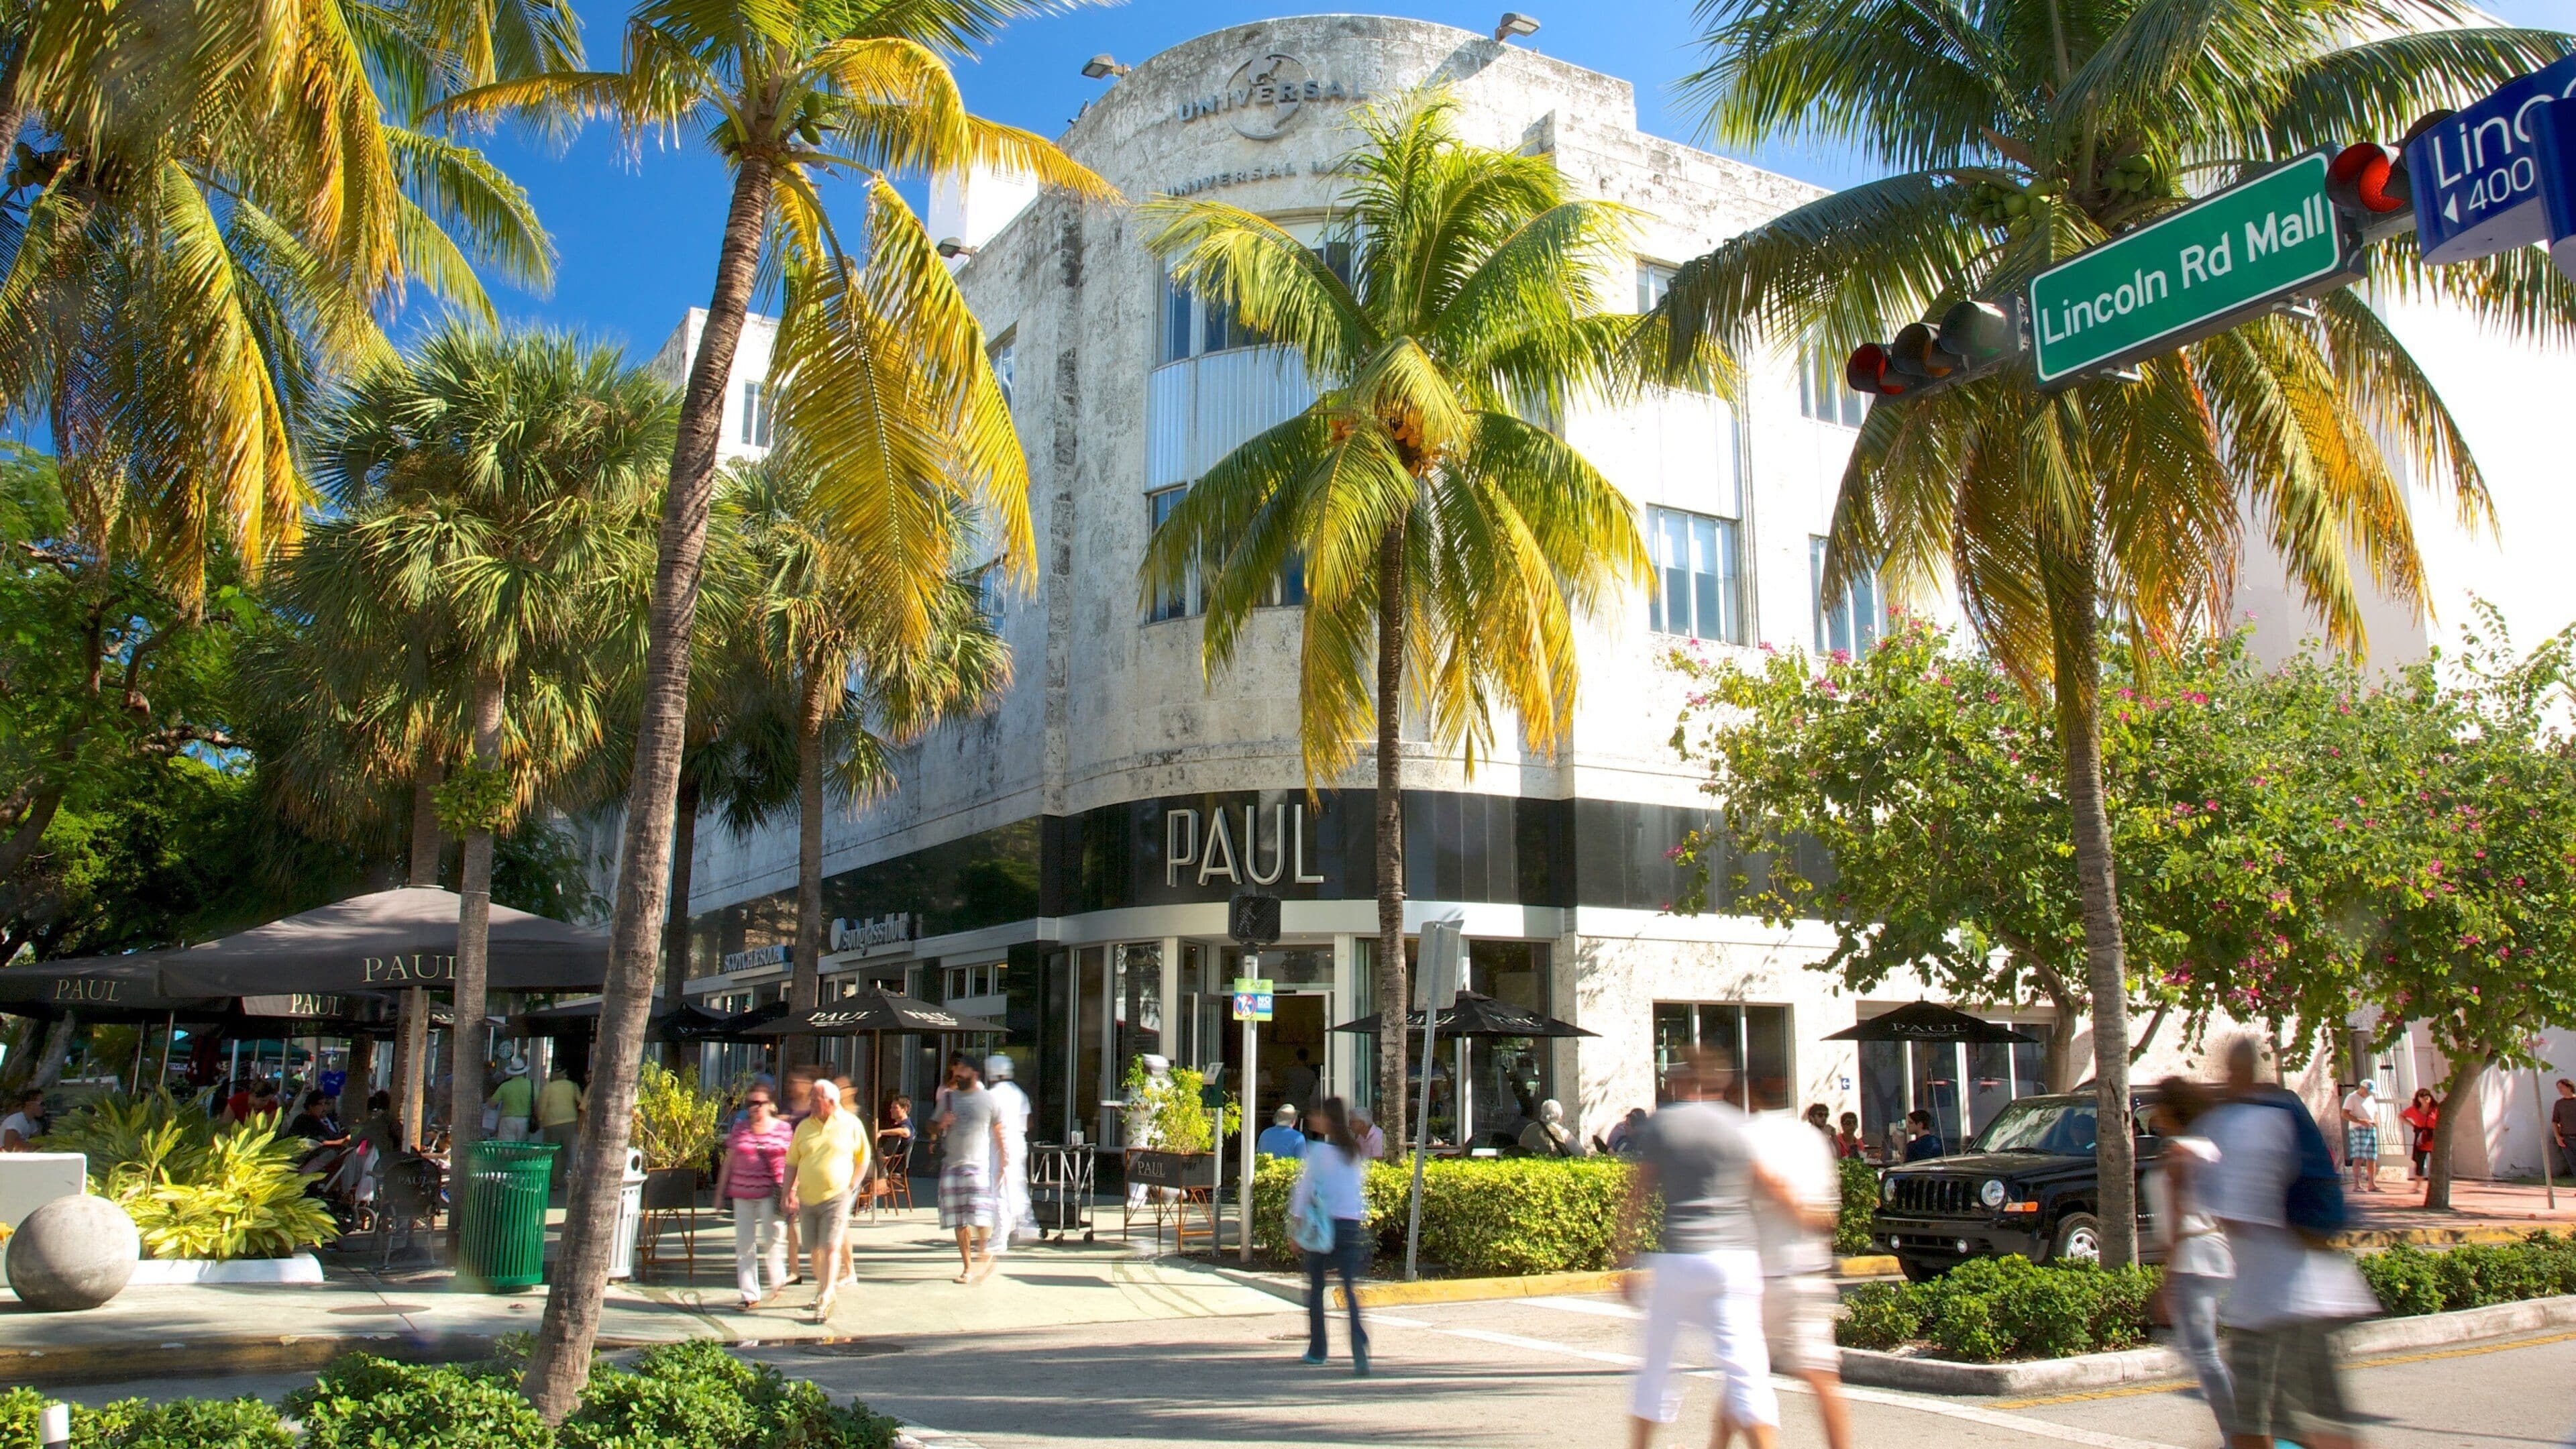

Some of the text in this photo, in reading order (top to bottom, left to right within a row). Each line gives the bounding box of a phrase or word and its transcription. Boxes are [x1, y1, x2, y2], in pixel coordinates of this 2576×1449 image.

[1177, 80, 1368, 122] UNIVERSAL
[2434, 78, 2576, 189] Linc
[1164, 162, 1297, 197] UNIVERSAL
[2468, 157, 2534, 209] 400
[2042, 192, 2325, 345] Lincoln Rd Mall
[1167, 804, 1325, 888] PAUL
[54, 979, 121, 1002] PAUL
[289, 994, 343, 1016] PAUL
[806, 1011, 871, 1021] PAUL
[1890, 1022, 1968, 1033] PAUL
[1138, 1161, 1165, 1177] PAUL
